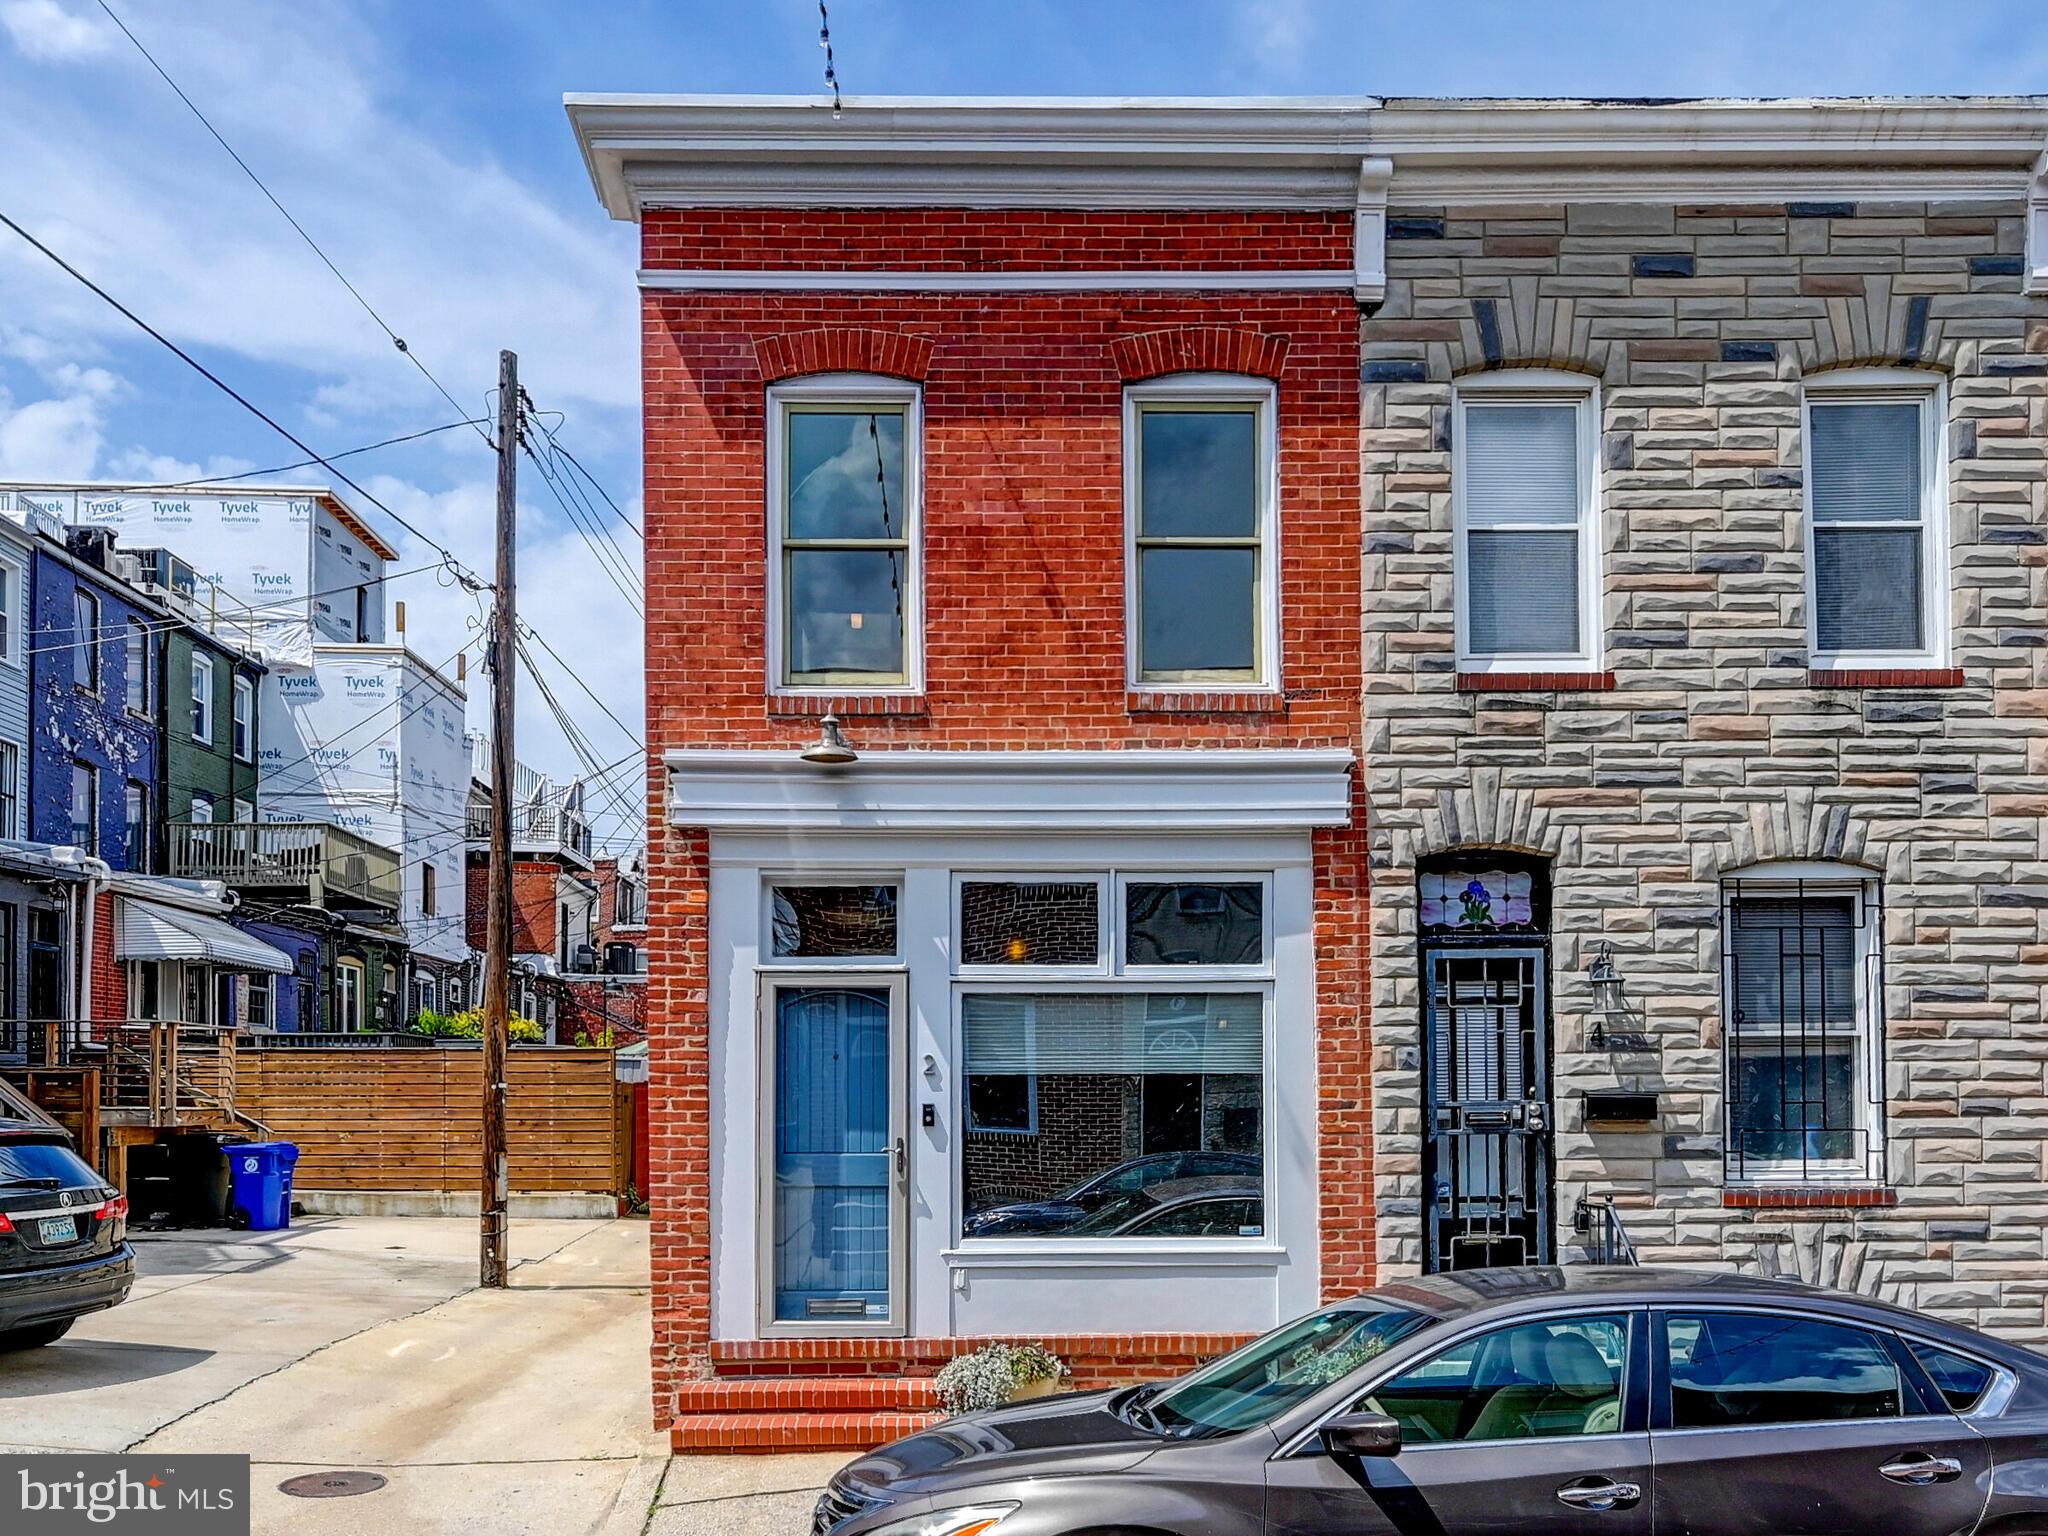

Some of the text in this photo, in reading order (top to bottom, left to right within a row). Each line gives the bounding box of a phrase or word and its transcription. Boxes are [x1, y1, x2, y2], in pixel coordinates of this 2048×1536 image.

[84, 501, 122, 515] Tyvek
[152, 501, 191, 515] Tyvek
[219, 501, 258, 515] Tyvek
[252, 573, 291, 587] Tyvek
[278, 675, 316, 689] Tyvek
[344, 675, 384, 690] Tyvek
[310, 748, 349, 761] Tyvek
[333, 813, 372, 828] Tyvek
[1590, 1021, 1604, 1047] 4
[924, 1054, 936, 1076] 2
